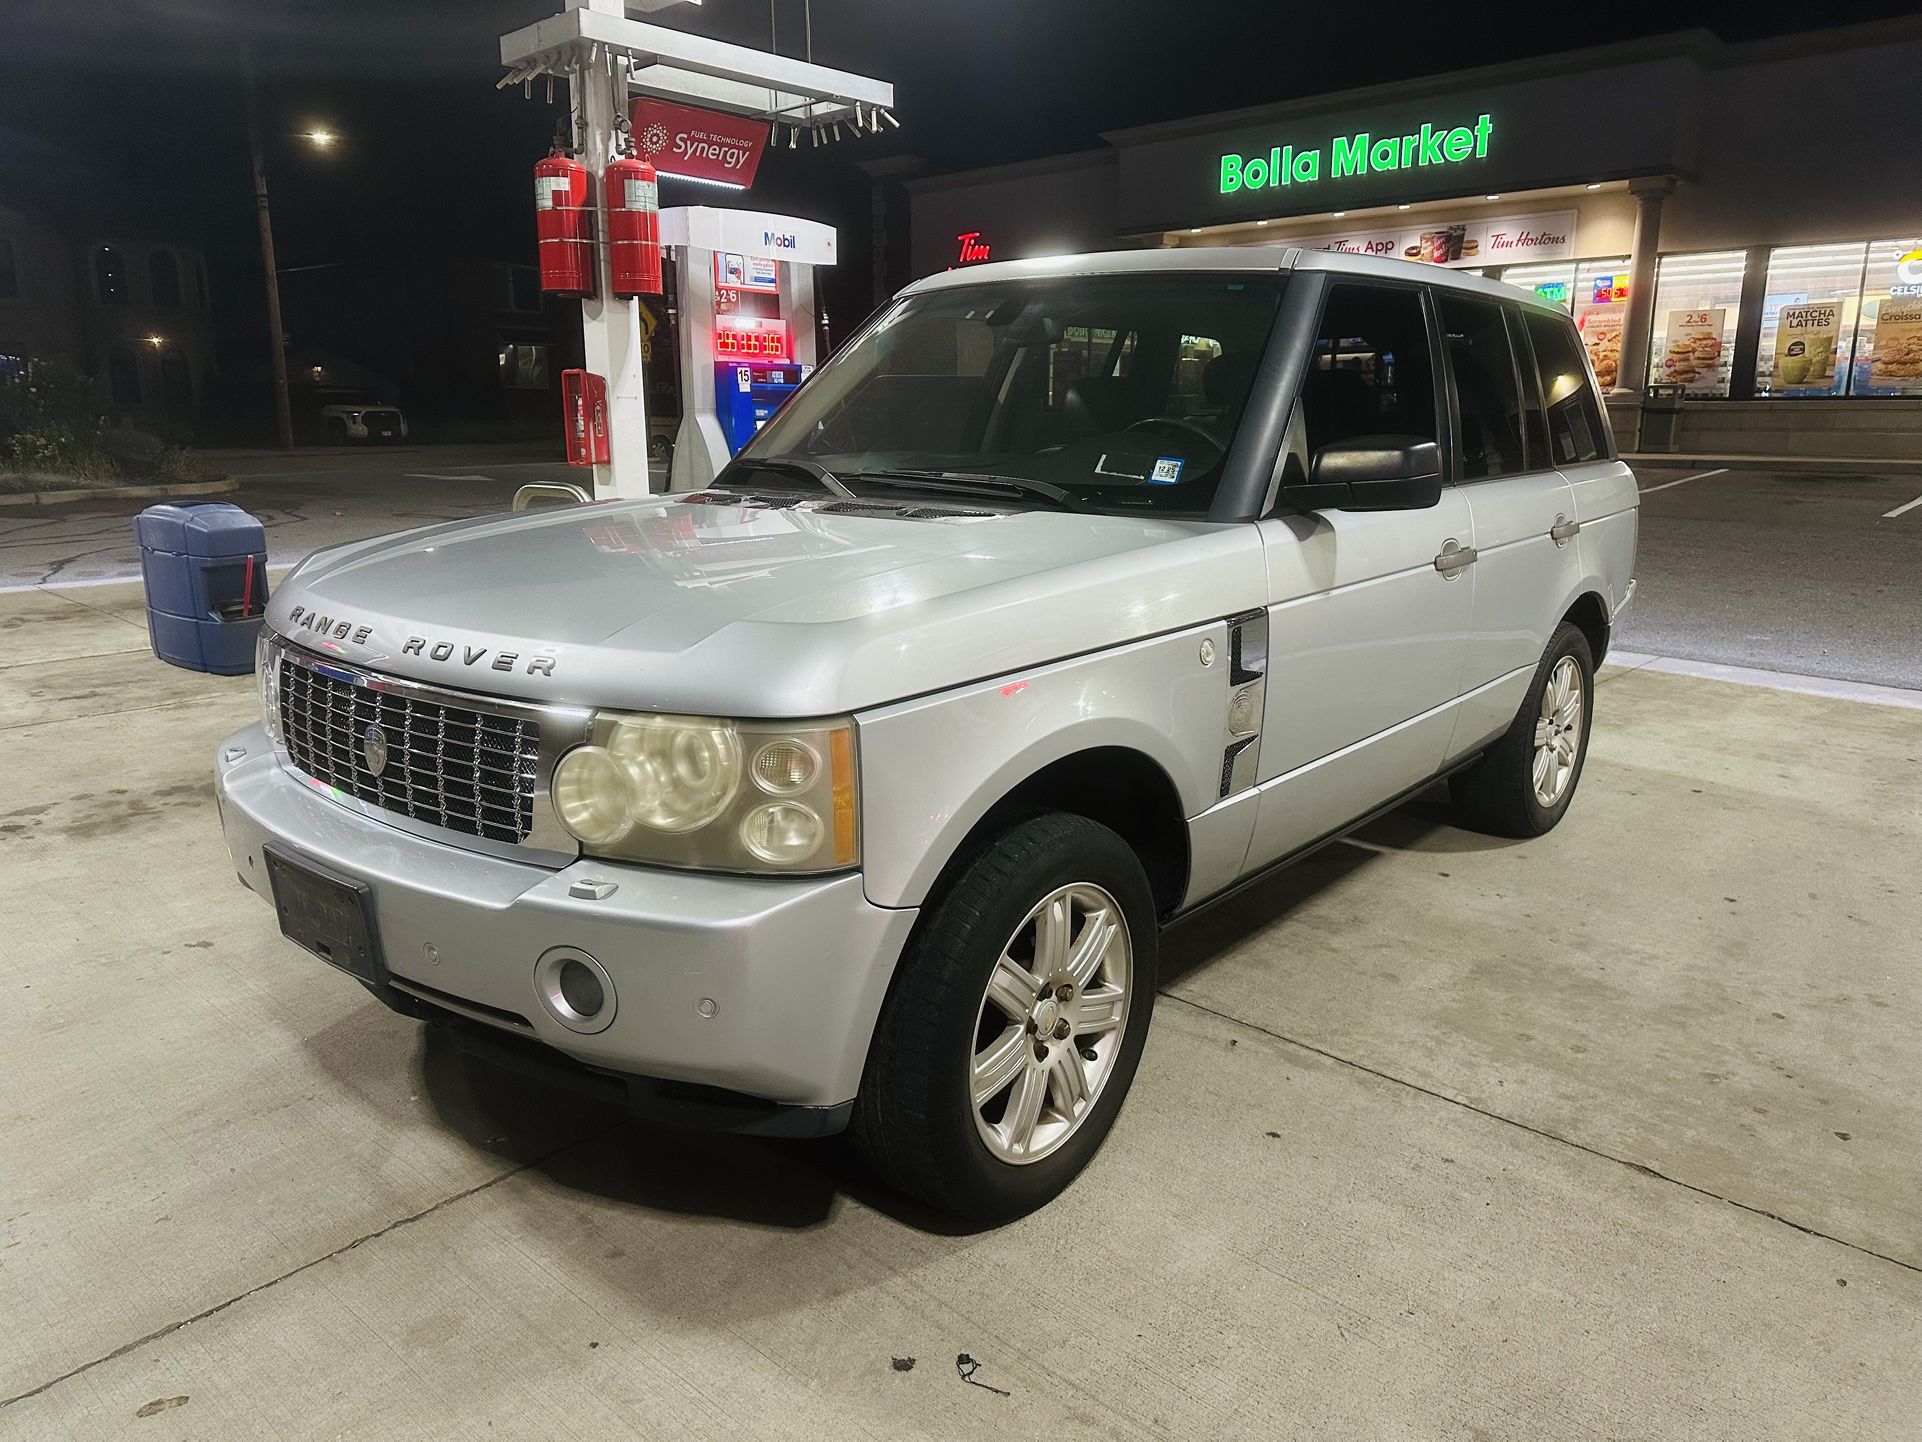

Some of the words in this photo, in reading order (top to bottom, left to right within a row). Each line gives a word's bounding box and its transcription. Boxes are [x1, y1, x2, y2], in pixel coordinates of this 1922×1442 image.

[690, 130, 708, 140] FUEL
[709, 133, 753, 148] TECHNOLOGY
[672, 133, 750, 169] Synergy
[1220, 145, 1320, 194] Bolla
[1331, 114, 1493, 178] Market
[764, 232, 796, 249] Mobil
[957, 232, 990, 262] Tim
[1364, 240, 1395, 254] App
[1491, 233, 1514, 249] Tim
[1515, 231, 1567, 247] Hortons
[1536, 287, 1565, 299] ATM
[1786, 309, 1835, 320] MATCHA
[1789, 318, 1830, 328] LATTES
[739, 369, 750, 382] 15
[289, 605, 373, 645] RANGE
[402, 636, 557, 677] ROVER
